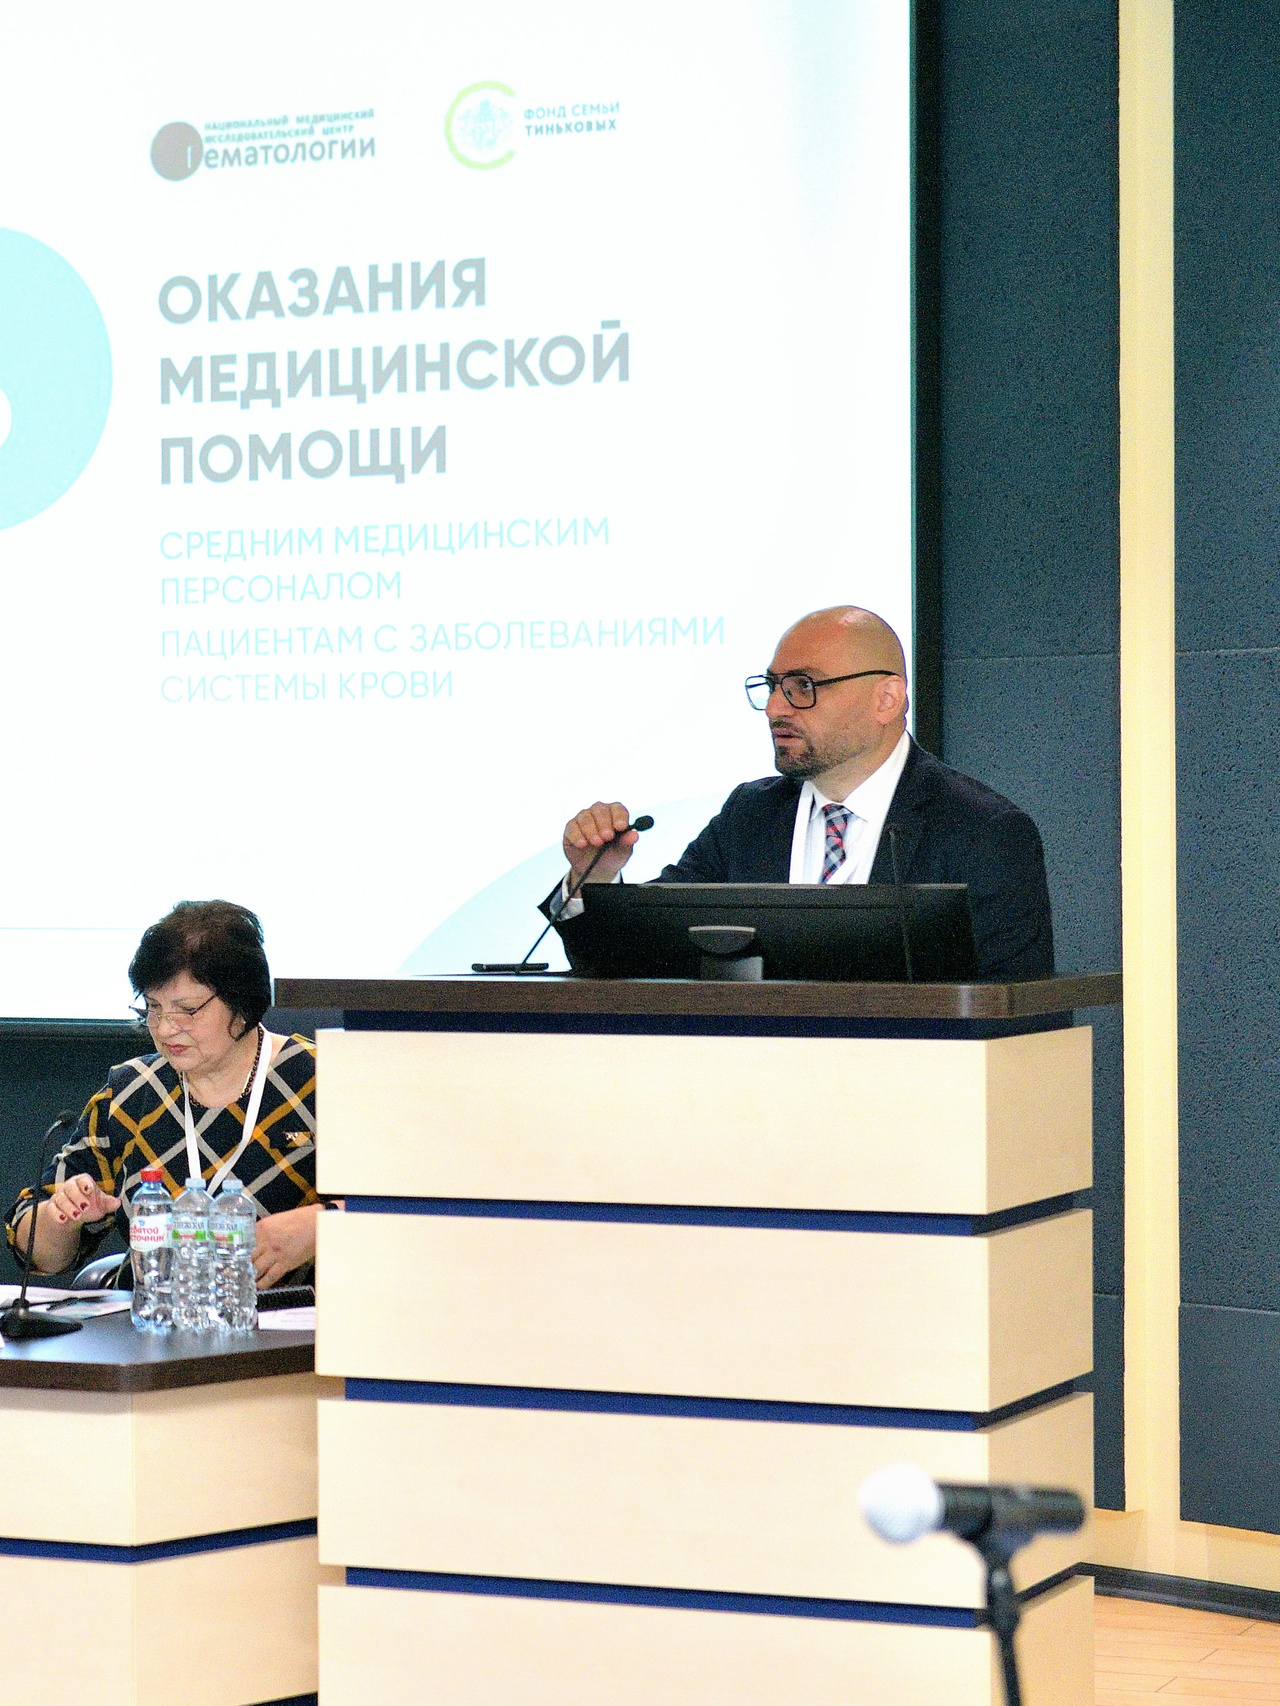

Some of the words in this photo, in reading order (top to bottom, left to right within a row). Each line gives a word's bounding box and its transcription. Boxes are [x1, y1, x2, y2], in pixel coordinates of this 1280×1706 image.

[204, 115, 289, 131] НАЦИОНАЛЬНЫЙ
[296, 108, 375, 125] МЕДИЦИНСКИЙ
[523, 106, 567, 121] ФОНД
[570, 101, 621, 118] СЕМЬИ
[524, 118, 618, 137] ТИНЬКОВЫХ
[321, 124, 354, 136] ЦЕНТР
[157, 256, 487, 326] ОКАЗАНИЯ
[159, 318, 631, 411] МЕДИЦИНСКОЙ
[160, 424, 448, 486] ПОМОЩИ
[159, 525, 324, 563] СРЕДНИМ
[333, 516, 610, 557] МЕДИЦИНСКИМ
[160, 569, 402, 606] ПЕРСОНАЛОМ
[160, 625, 363, 661] ПАЦИЕНТАМ
[373, 624, 398, 653] С
[409, 615, 726, 653] ЗАБОЛЕВАНИЯМИ
[159, 671, 327, 704] СИСТЕМЫ
[338, 669, 454, 700] КРОВИ
